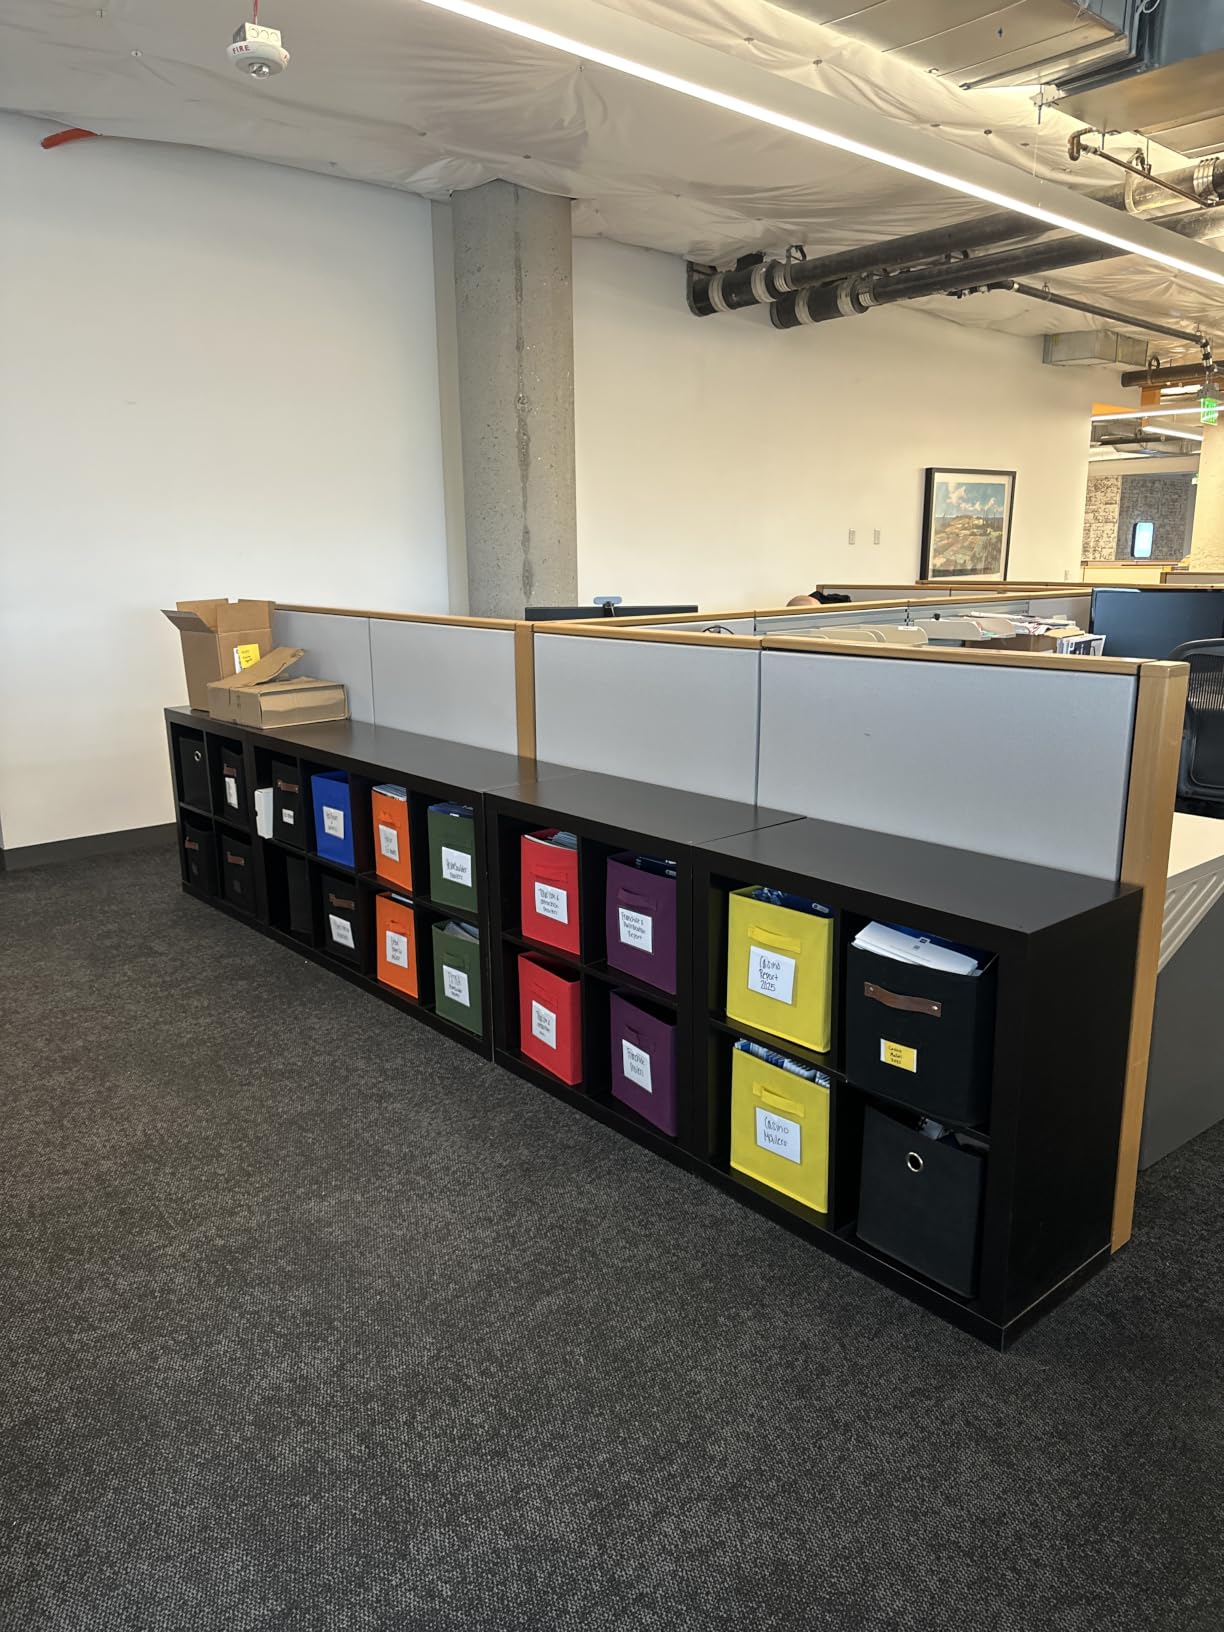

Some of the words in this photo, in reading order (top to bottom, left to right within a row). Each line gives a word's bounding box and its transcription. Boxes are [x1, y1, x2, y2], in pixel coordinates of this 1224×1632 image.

[232, 44, 251, 55] FIRE
[759, 955, 781, 970] Casino
[758, 968, 778, 981] Report
[760, 980, 776, 992] 2025
[764, 1116, 790, 1134] Casino
